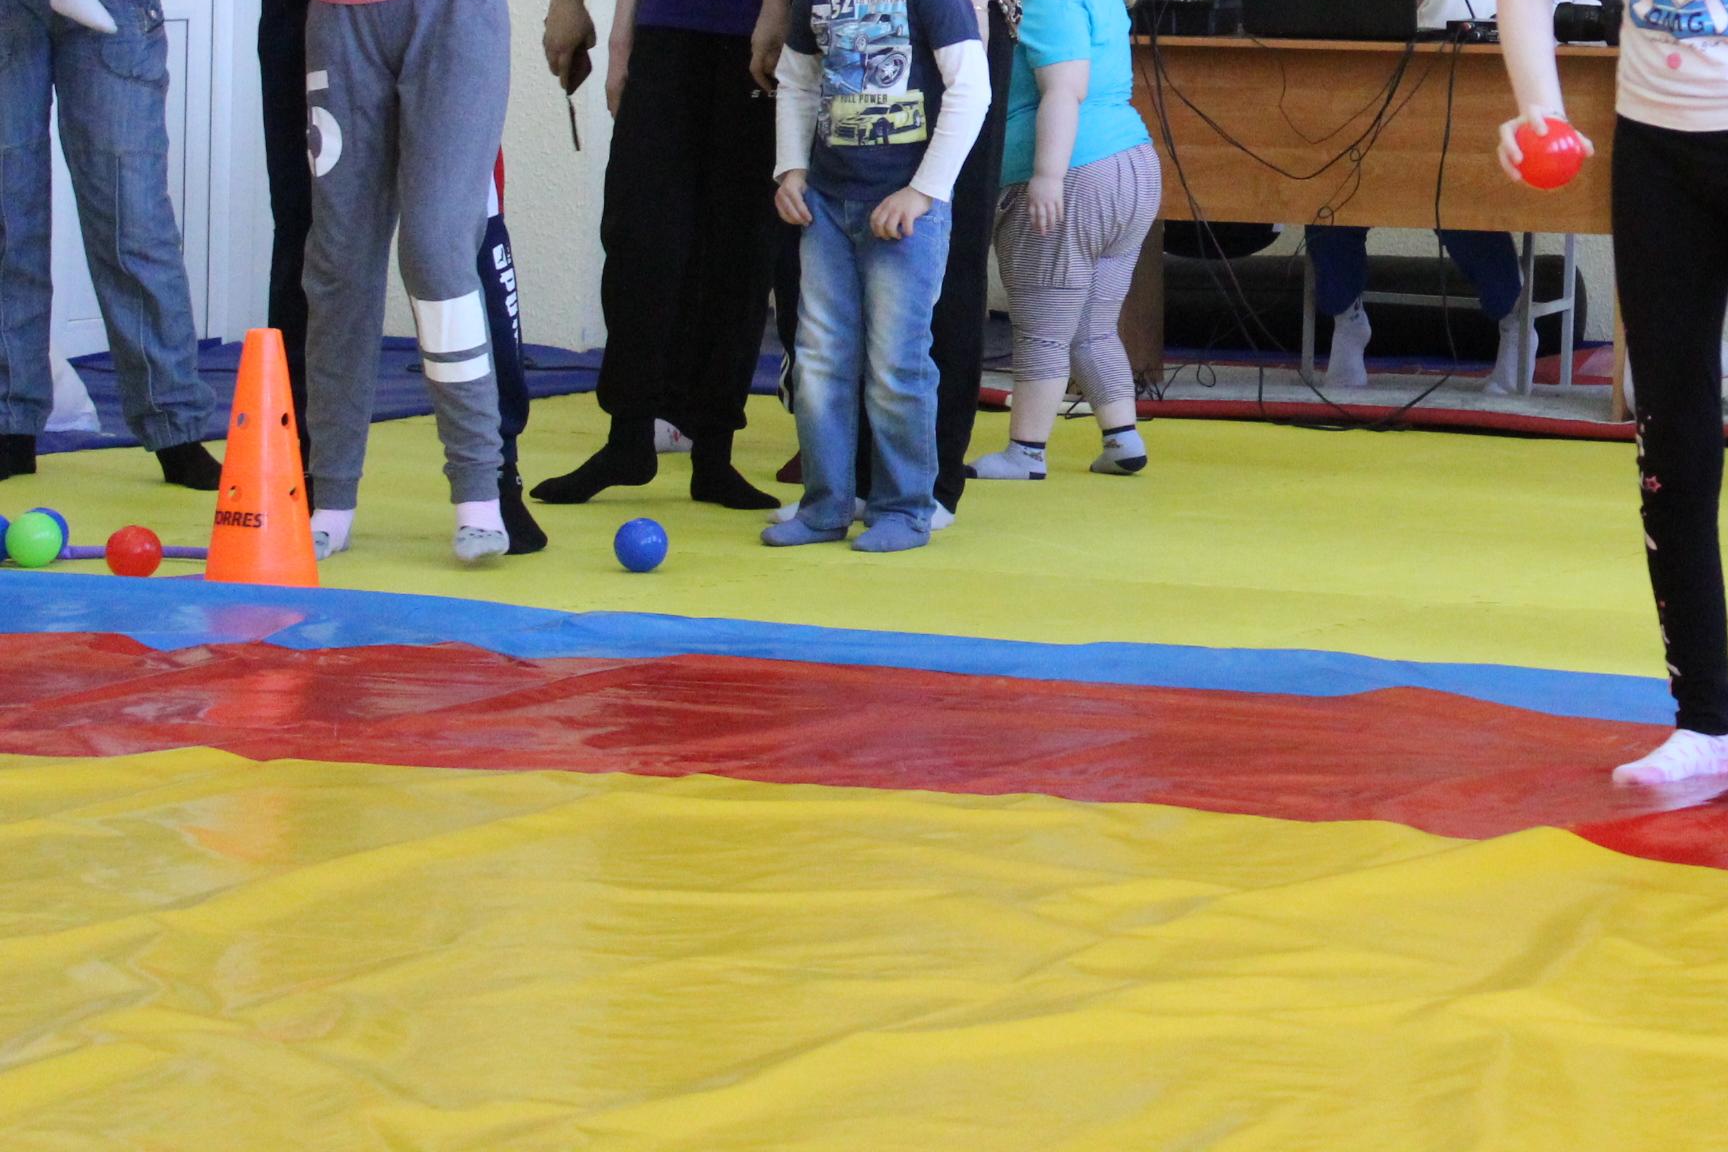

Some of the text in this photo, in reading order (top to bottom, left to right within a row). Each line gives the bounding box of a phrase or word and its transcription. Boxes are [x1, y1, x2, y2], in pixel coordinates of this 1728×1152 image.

[1645, 8, 1704, 33] OMG
[858, 94, 888, 104] POWER
[215, 510, 263, 528] ORRES
